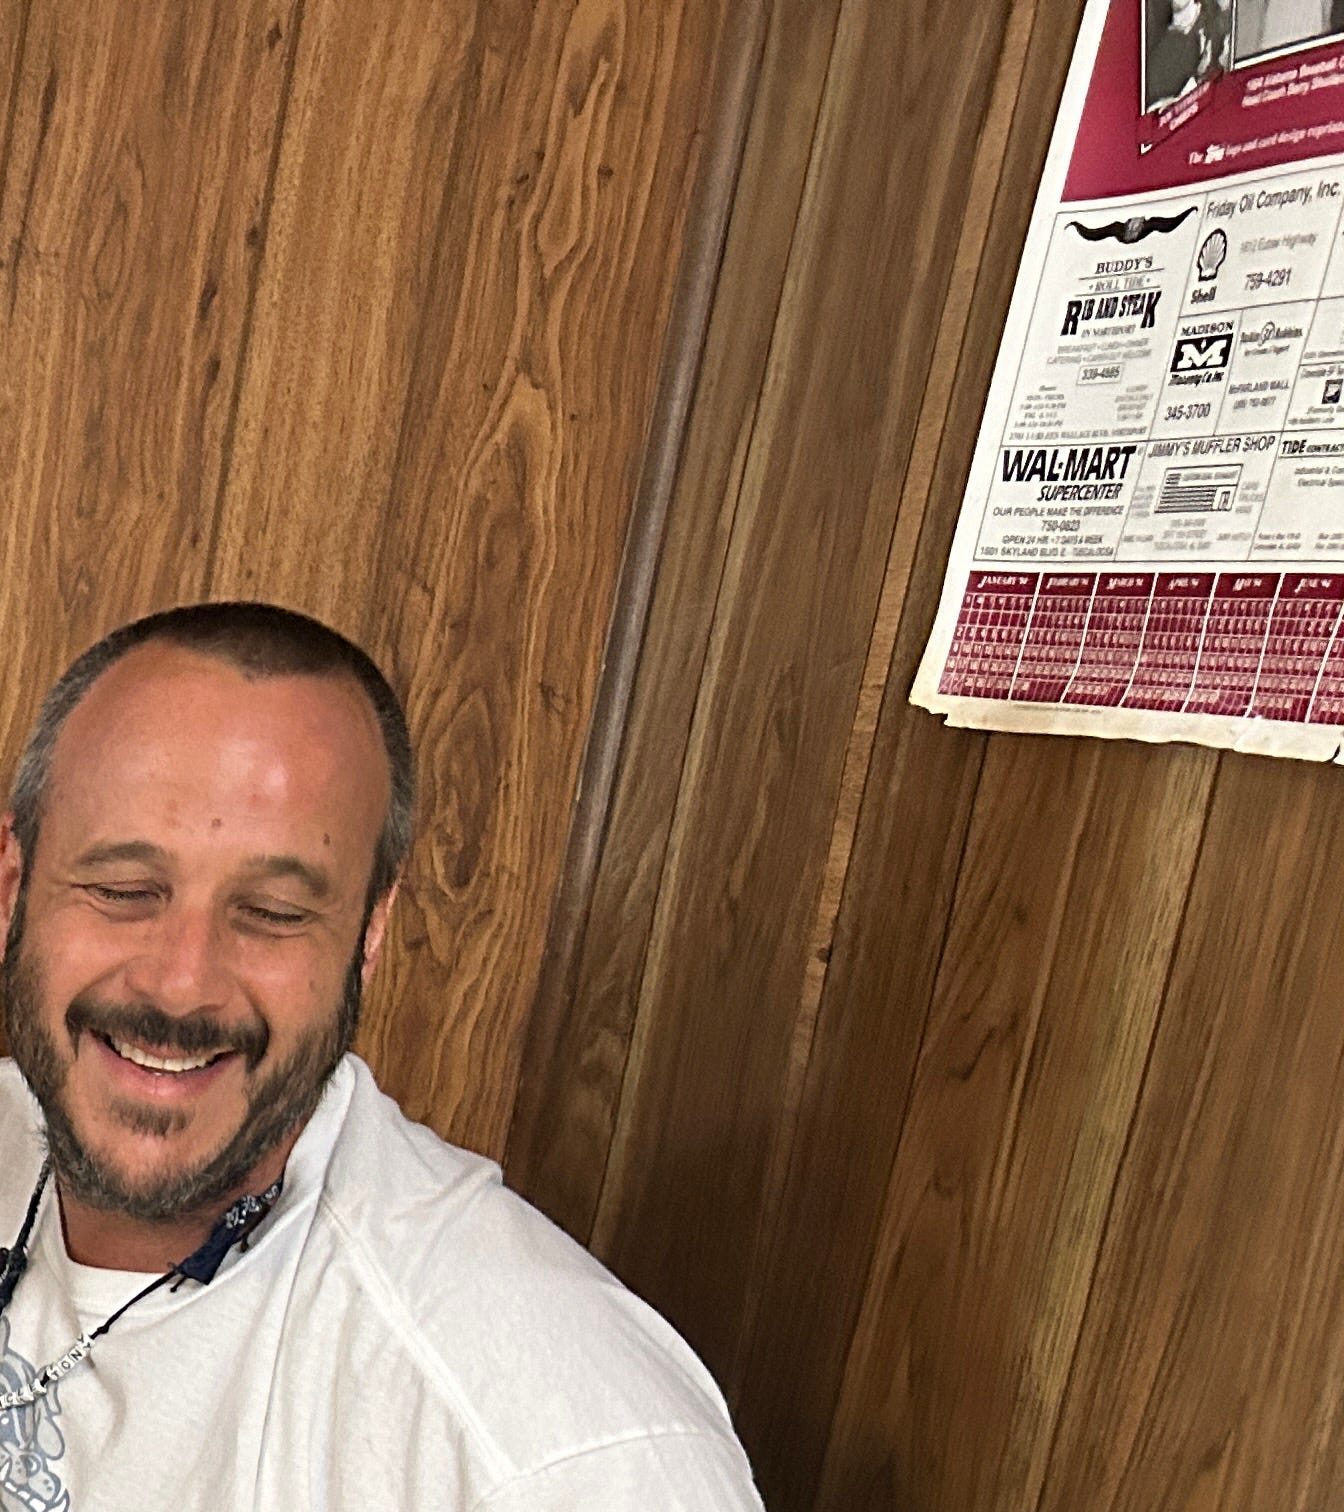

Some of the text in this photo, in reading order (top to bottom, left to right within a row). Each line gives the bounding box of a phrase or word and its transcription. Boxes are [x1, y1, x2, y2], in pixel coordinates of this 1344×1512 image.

[1207, 180, 1341, 219] Friday Oil Company, Inc.
[1095, 256, 1153, 274] BUDDY'S
[1190, 286, 1217, 304] Shell
[1095, 296, 1118, 319] AND
[1118, 290, 1162, 328] STEAK
[1181, 320, 1234, 336] MADISON
[1148, 436, 1276, 458] JIMMY'S MUFFLER SHOP
[1281, 440, 1306, 455] TIDE
[1036, 483, 1124, 502] SUPERCENTER
[48, 1333, 93, 1379] TONY
